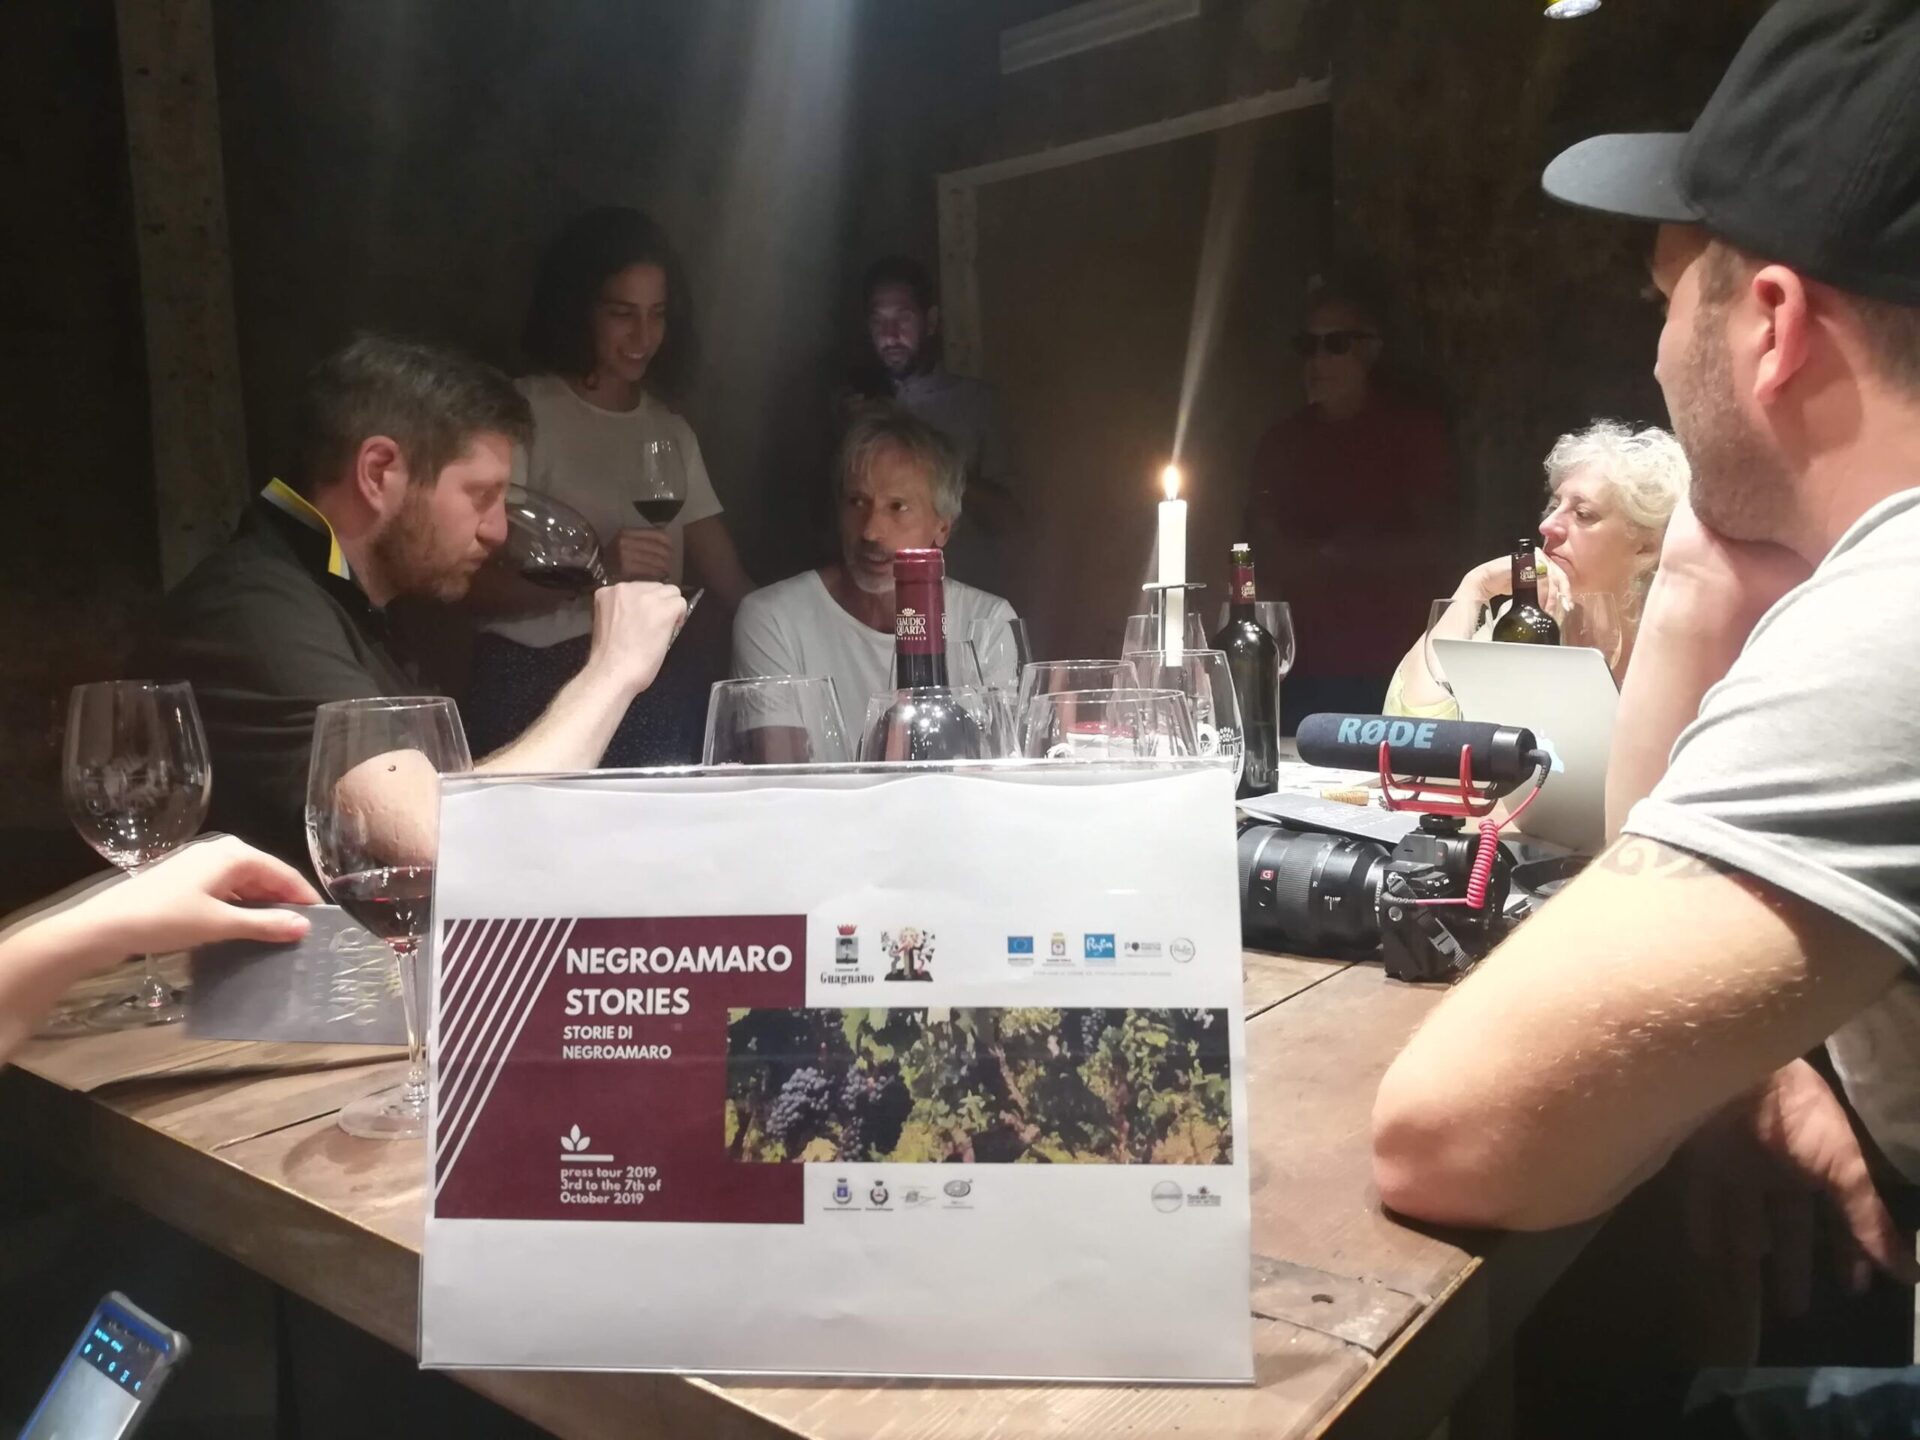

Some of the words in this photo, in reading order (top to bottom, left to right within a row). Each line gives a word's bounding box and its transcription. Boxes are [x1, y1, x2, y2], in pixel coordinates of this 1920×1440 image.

[896, 625, 926, 636] QUARTA
[565, 945, 793, 975] NEGROAMARO
[820, 972, 875, 987] Guagnano
[564, 987, 691, 1016] STORIES
[562, 1025, 615, 1040] STORIE
[618, 1025, 633, 1040] DI
[562, 1045, 672, 1060] NEGROAMARO
[560, 1168, 594, 1180] press
[596, 1167, 623, 1178] tour
[626, 1166, 657, 1178] 2019
[560, 1178, 583, 1190] 3rd
[585, 1180, 598, 1191] to
[601, 1179, 621, 1191] the
[624, 1178, 645, 1191] 7th
[647, 1179, 662, 1191] of
[560, 1191, 610, 1204] October
[613, 1192, 644, 1205] 2019
